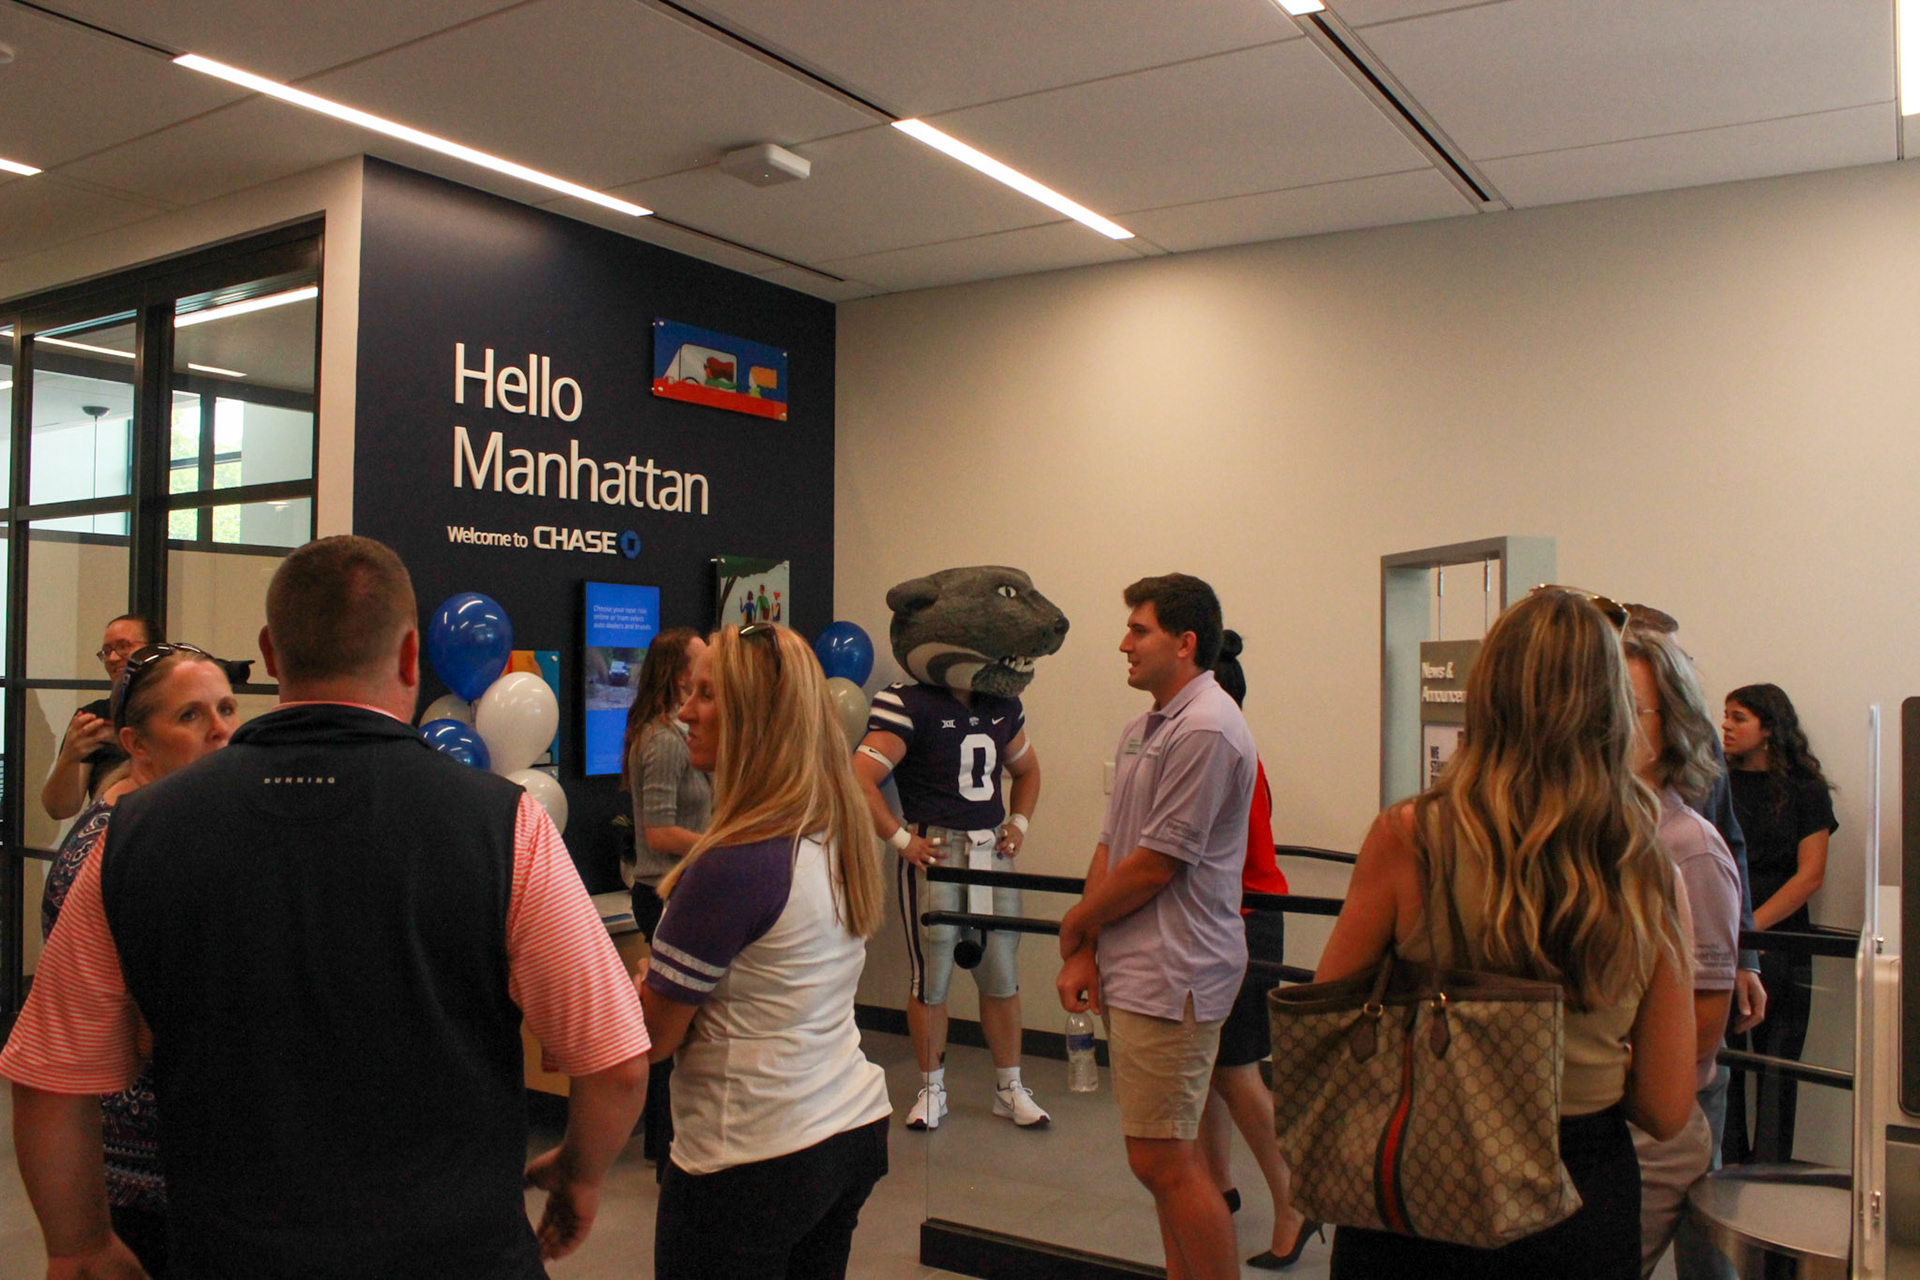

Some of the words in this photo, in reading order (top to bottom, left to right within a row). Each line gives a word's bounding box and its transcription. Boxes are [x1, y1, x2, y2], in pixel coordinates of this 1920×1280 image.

[454, 342, 584, 423] Hello
[453, 425, 710, 516] Manhattan
[446, 525, 512, 547] Welcome
[512, 532, 529, 549] to
[533, 525, 618, 555] CHASE
[1422, 662, 1445, 678] News
[1446, 662, 1454, 678] &
[958, 733, 997, 802] 0
